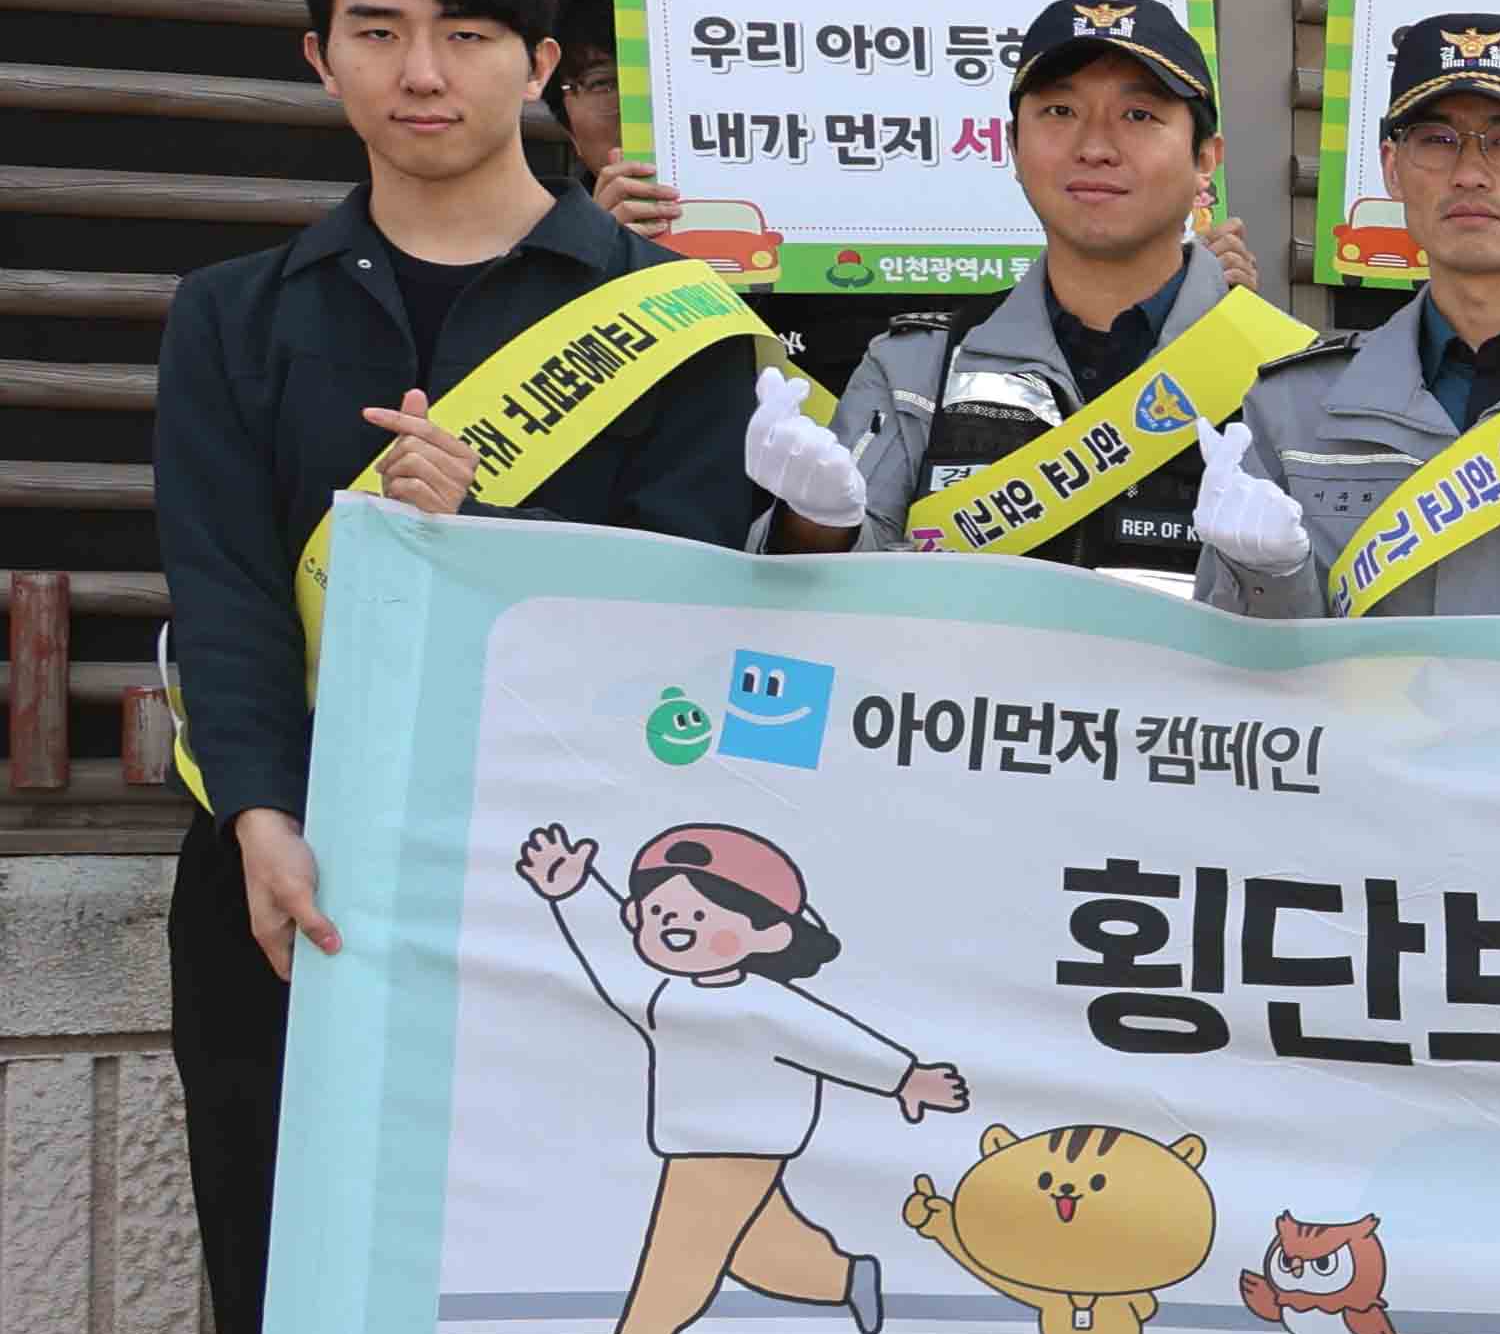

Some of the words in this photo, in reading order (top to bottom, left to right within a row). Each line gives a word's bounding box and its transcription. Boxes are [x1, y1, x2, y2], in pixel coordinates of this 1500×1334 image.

[690, 16, 796, 69] 우리
[815, 23, 925, 71] 아이
[690, 113, 807, 163] 내가
[824, 113, 933, 166] 먼저
[878, 256, 1003, 284] 인천광역시
[503, 313, 659, 435] 교통법규
[1040, 422, 1132, 499] 학교
[953, 479, 1047, 549] 앞길
[1121, 519, 1157, 537] REP.
[1161, 522, 1182, 539] OF
[1352, 510, 1422, 592] 가는
[852, 691, 1119, 781] 아이먼저
[1136, 714, 1323, 795] 캠페인
